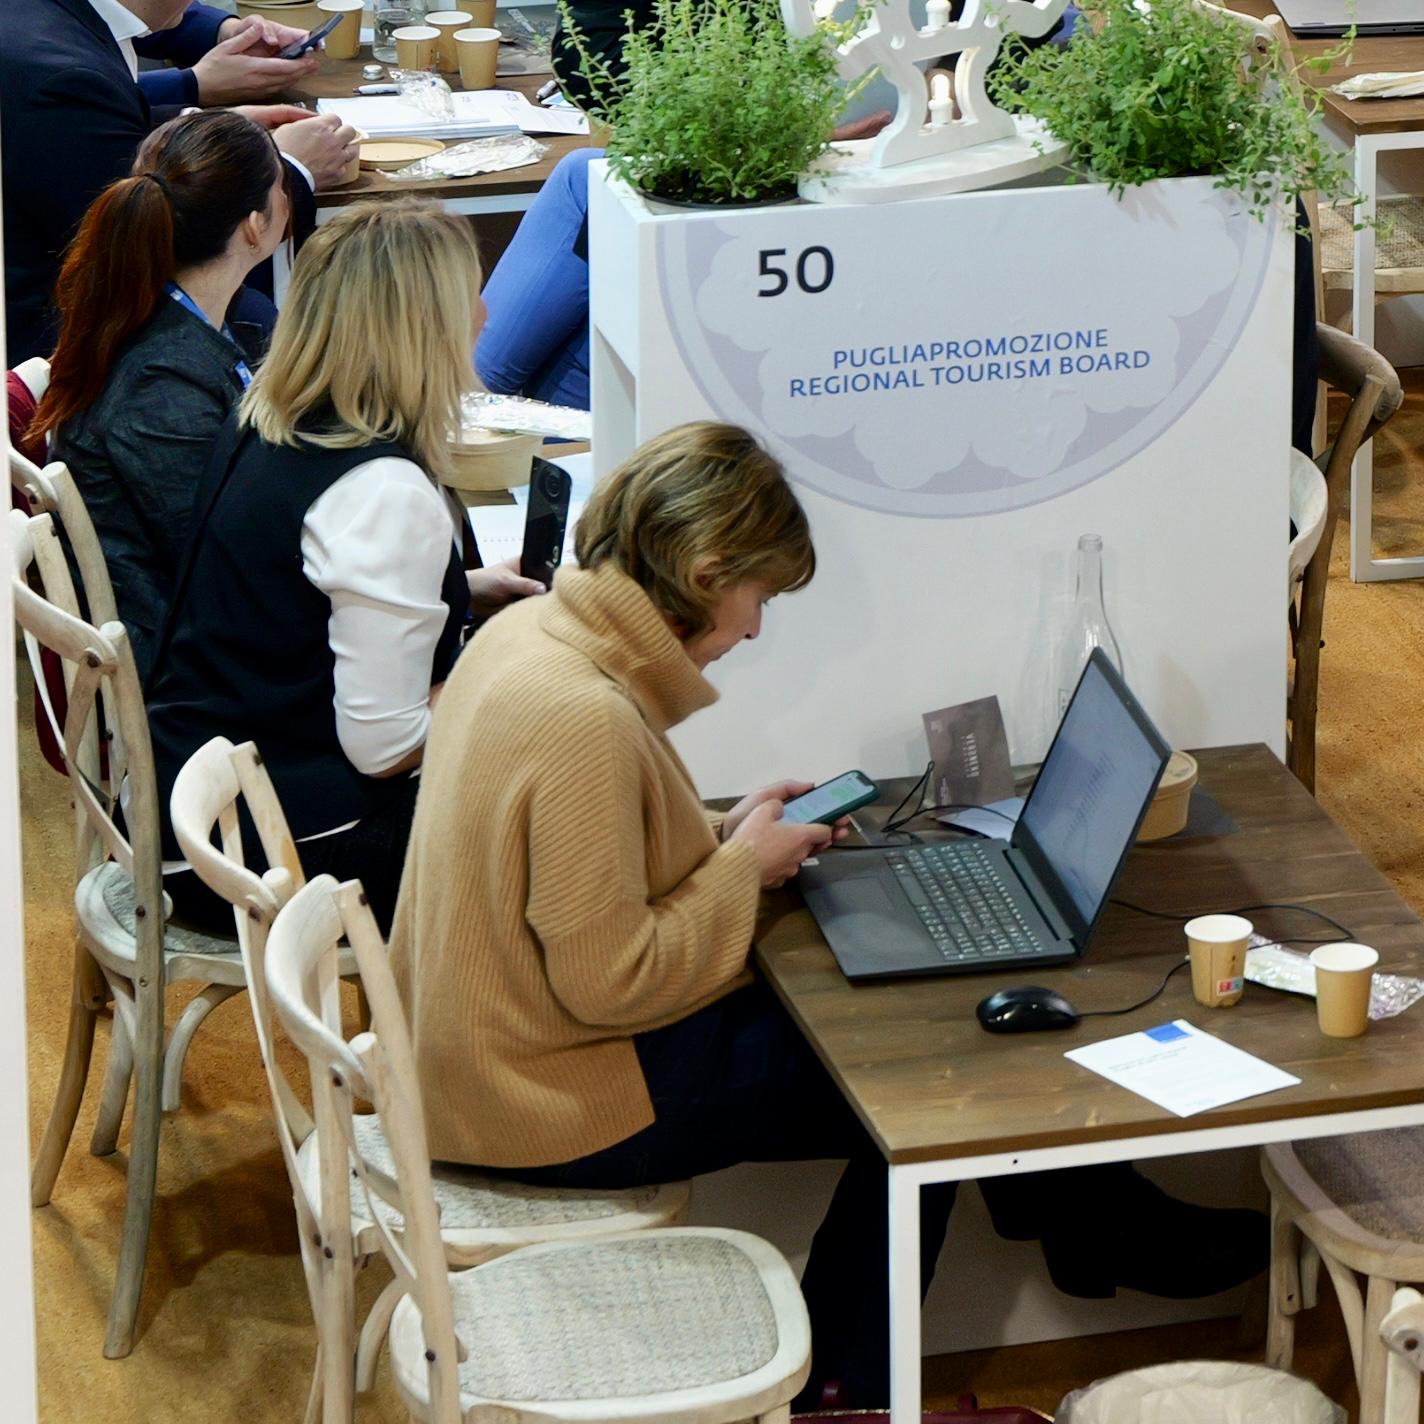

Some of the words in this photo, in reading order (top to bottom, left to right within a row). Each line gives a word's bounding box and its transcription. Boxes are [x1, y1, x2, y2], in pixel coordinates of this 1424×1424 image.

[757, 245, 834, 298] 50
[833, 328, 1109, 369] PUGLIAPROMOZIONE
[789, 369, 926, 398] REGIONAL
[931, 358, 1051, 387] TOURISM
[1059, 350, 1151, 376] BOARD
